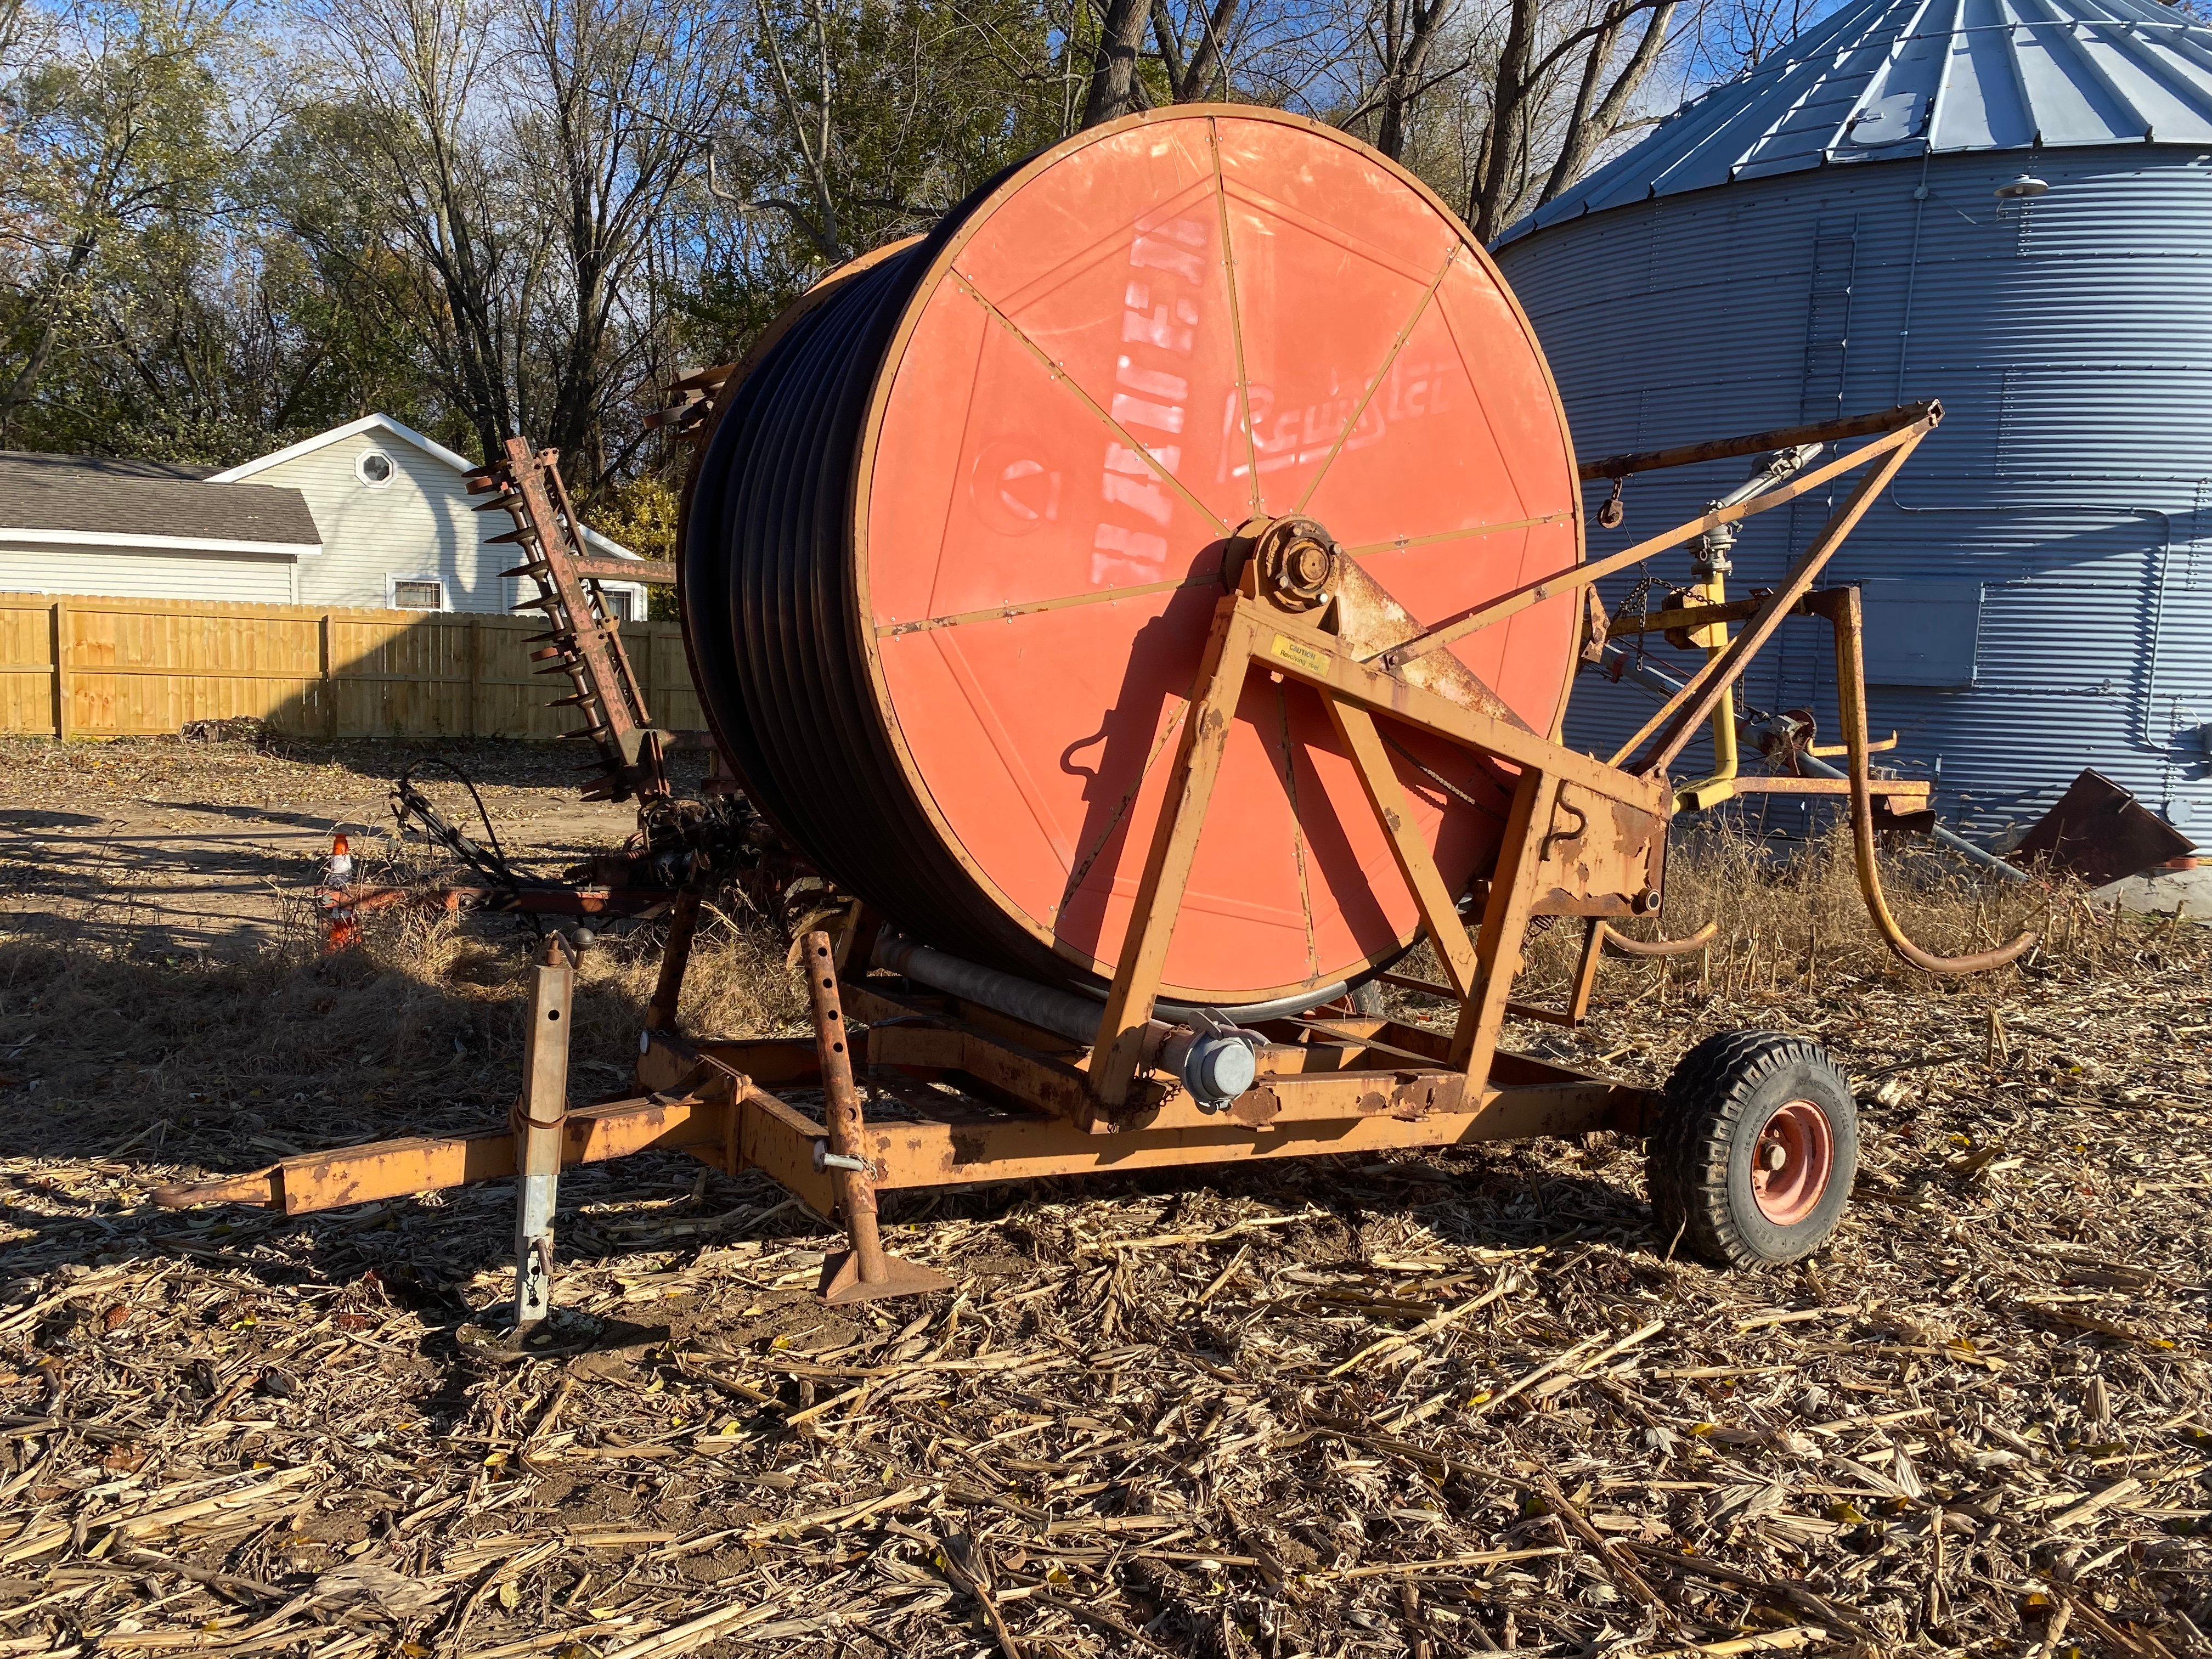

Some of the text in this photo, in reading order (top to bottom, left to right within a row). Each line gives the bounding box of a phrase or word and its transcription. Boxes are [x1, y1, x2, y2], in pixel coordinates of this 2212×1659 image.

[1280, 650, 1319, 671] Revolving reel
[1289, 644, 1316, 660] CAUTION
